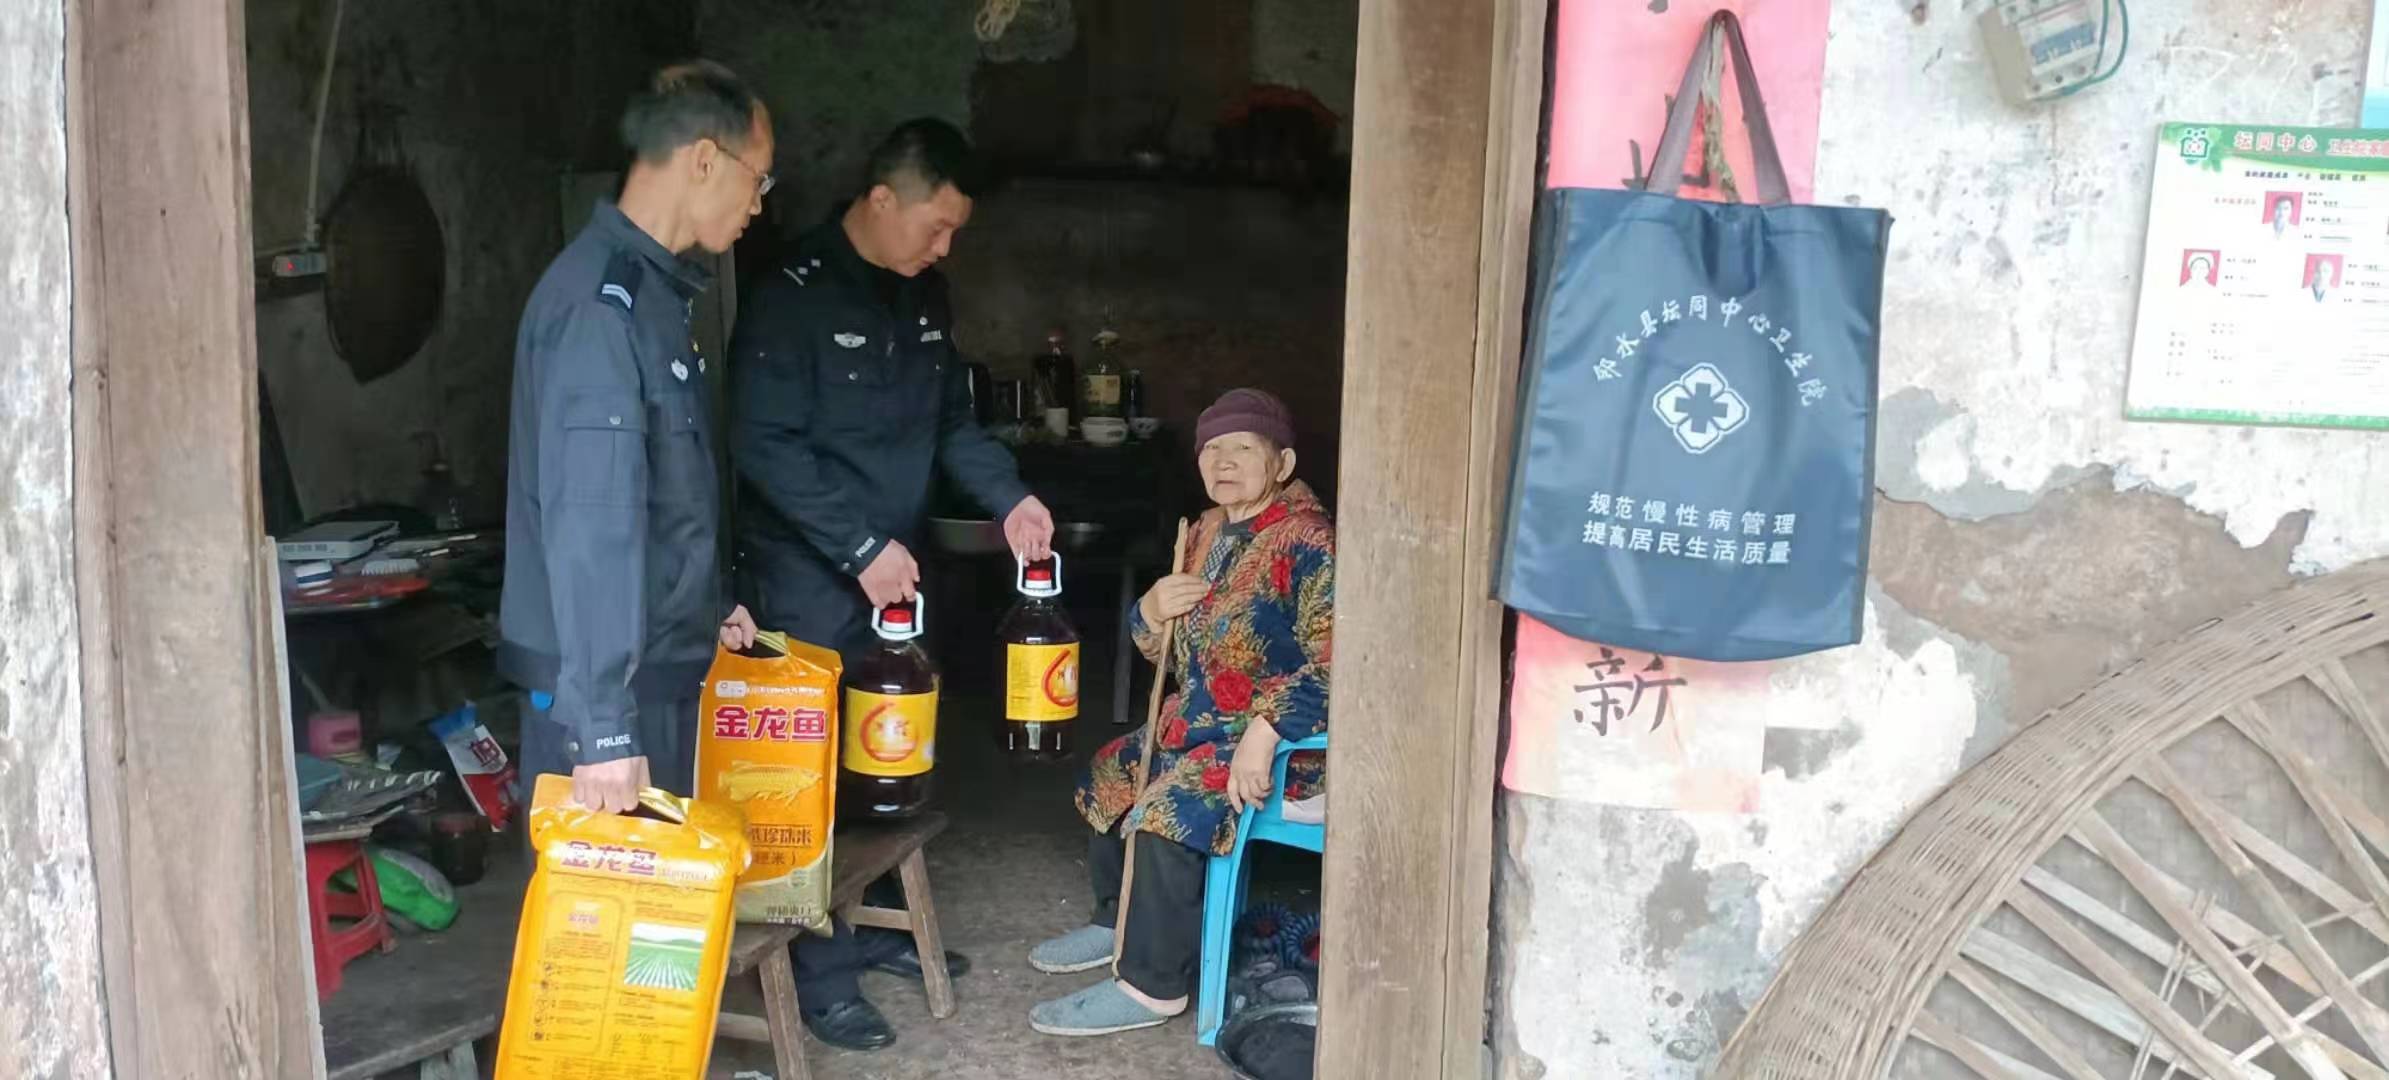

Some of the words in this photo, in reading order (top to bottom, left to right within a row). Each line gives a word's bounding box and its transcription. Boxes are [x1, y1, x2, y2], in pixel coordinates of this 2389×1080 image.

[1592, 294, 1828, 407] 邻水县坛同中心卫生院
[1587, 491, 1796, 535] 规范慢性病管理
[1582, 520, 1791, 564] 提高居民生活质量
[1573, 647, 1687, 736] 新
[596, 734, 631, 750] POLICE
[714, 704, 827, 742] 金龙鱼
